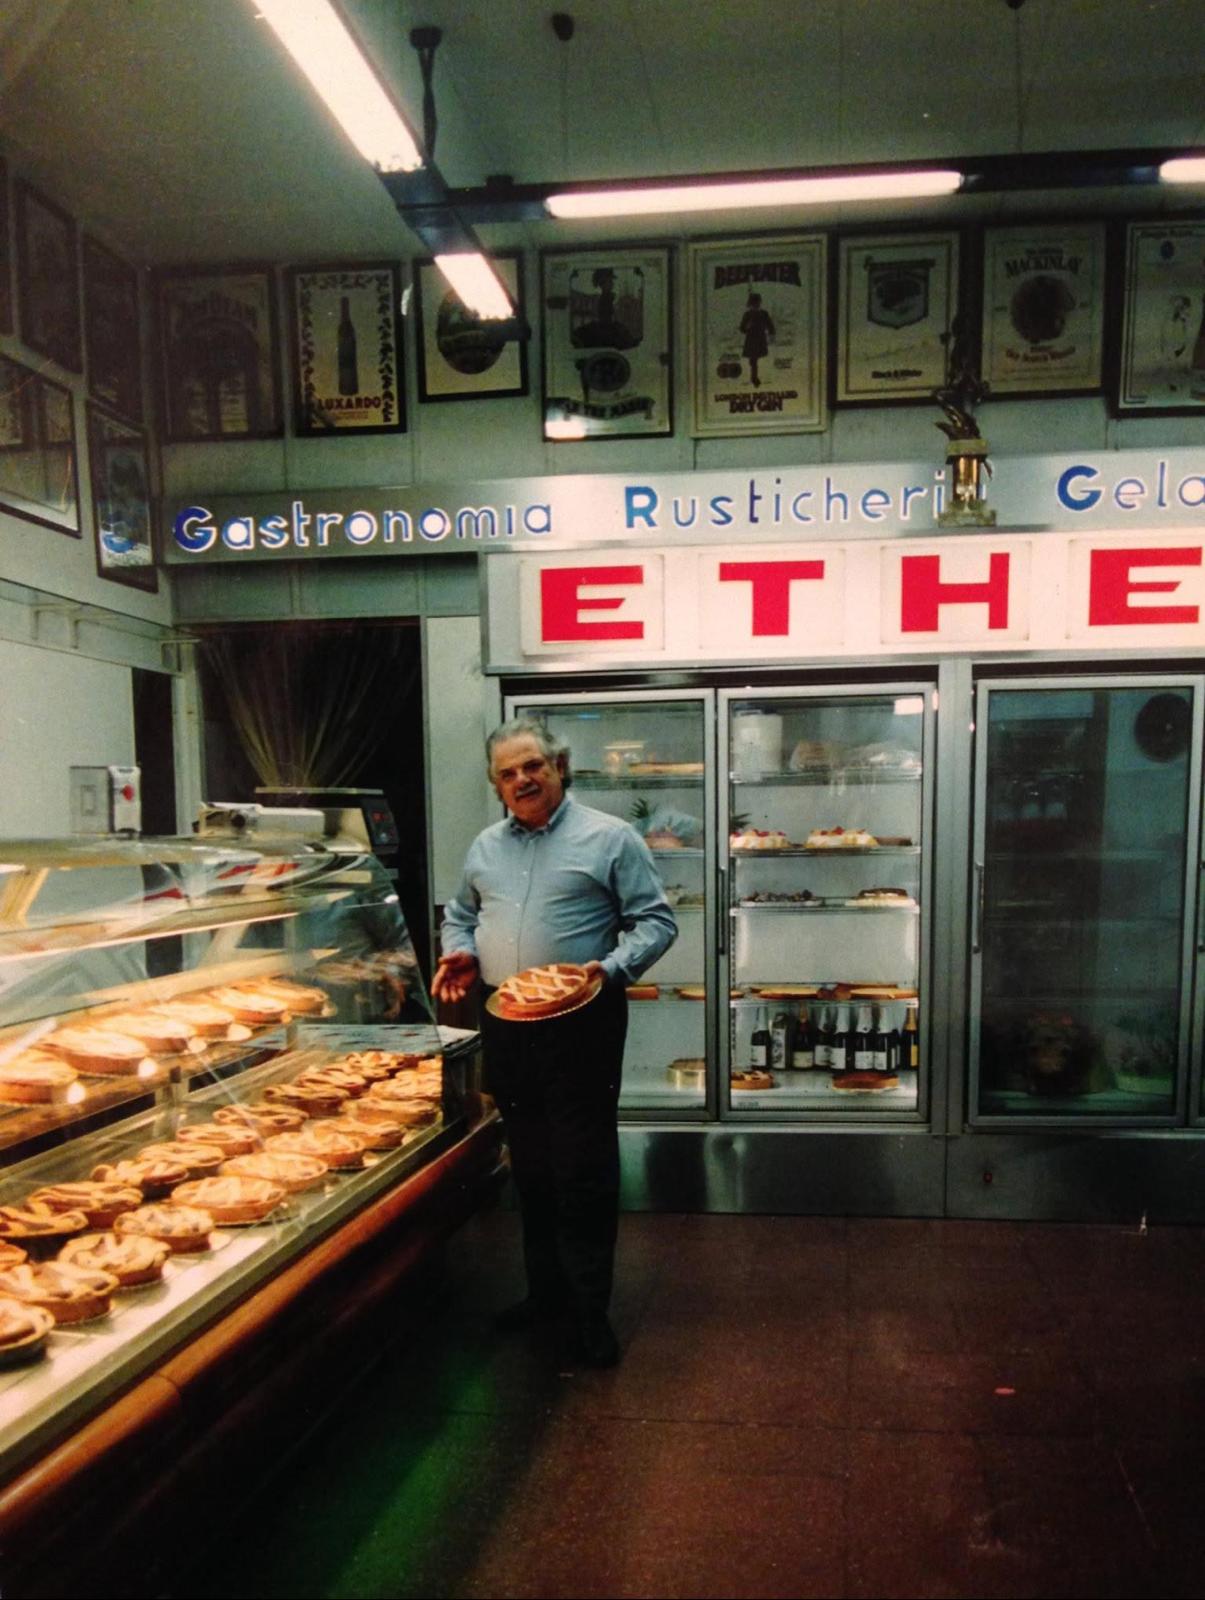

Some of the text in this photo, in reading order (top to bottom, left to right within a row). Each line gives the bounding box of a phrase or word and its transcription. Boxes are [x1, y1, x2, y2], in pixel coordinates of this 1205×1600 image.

[714, 261, 802, 289] BEEFEATER
[318, 396, 382, 411] LUXARDO
[714, 392, 750, 402] LONDON
[729, 398, 783, 413] DRY GIN
[173, 501, 551, 552] Gastronomia
[624, 471, 987, 528] Rusticheri
